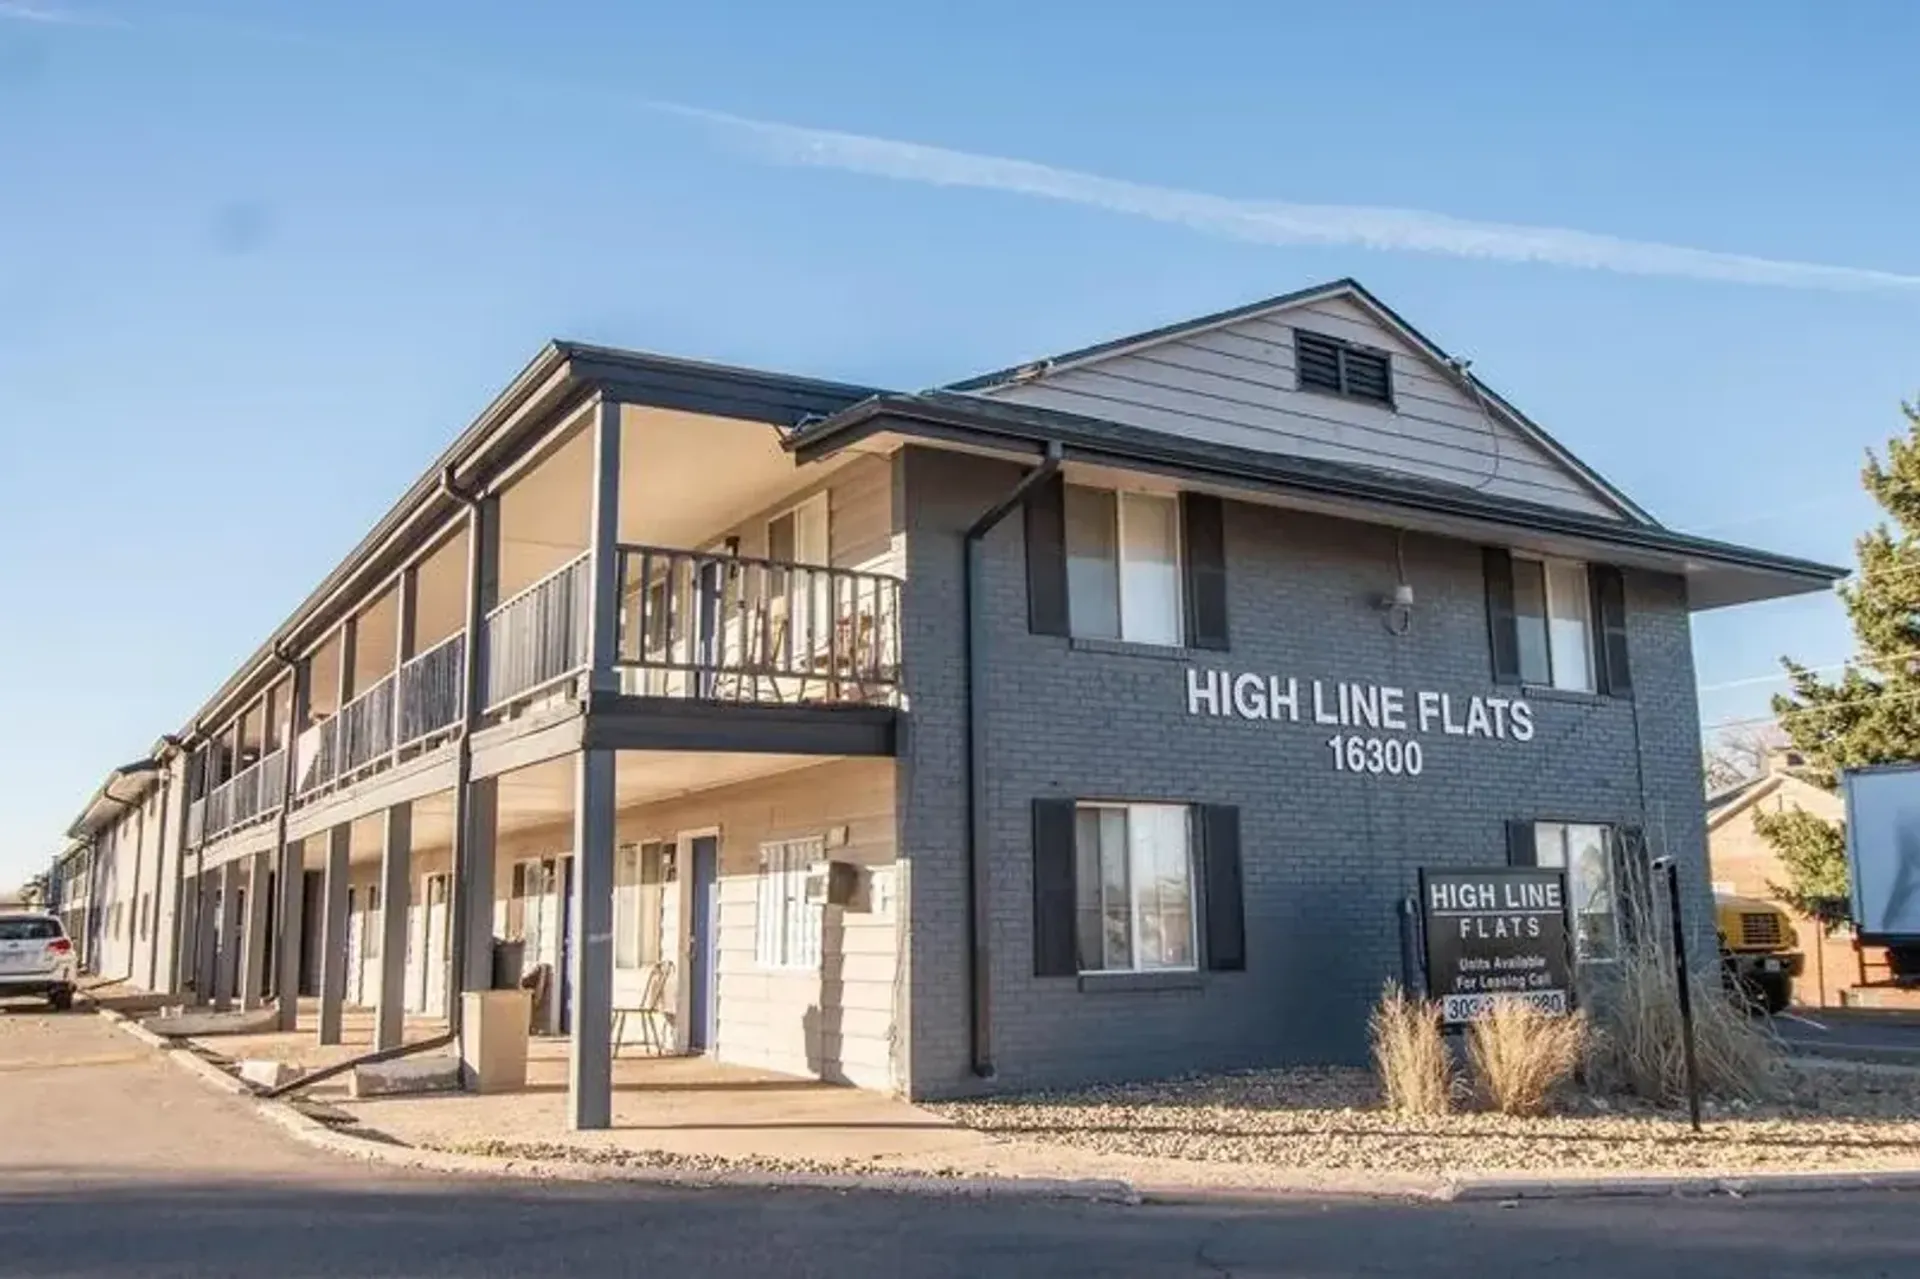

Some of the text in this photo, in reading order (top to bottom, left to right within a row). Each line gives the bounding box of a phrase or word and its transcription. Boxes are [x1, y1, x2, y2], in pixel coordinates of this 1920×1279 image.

[1186, 668, 1535, 742] HIGH LINE FLATS
[1328, 734, 1423, 776] 16300
[1430, 883, 1562, 909] HIGH LINE
[1459, 917, 1540, 939] FLATS
